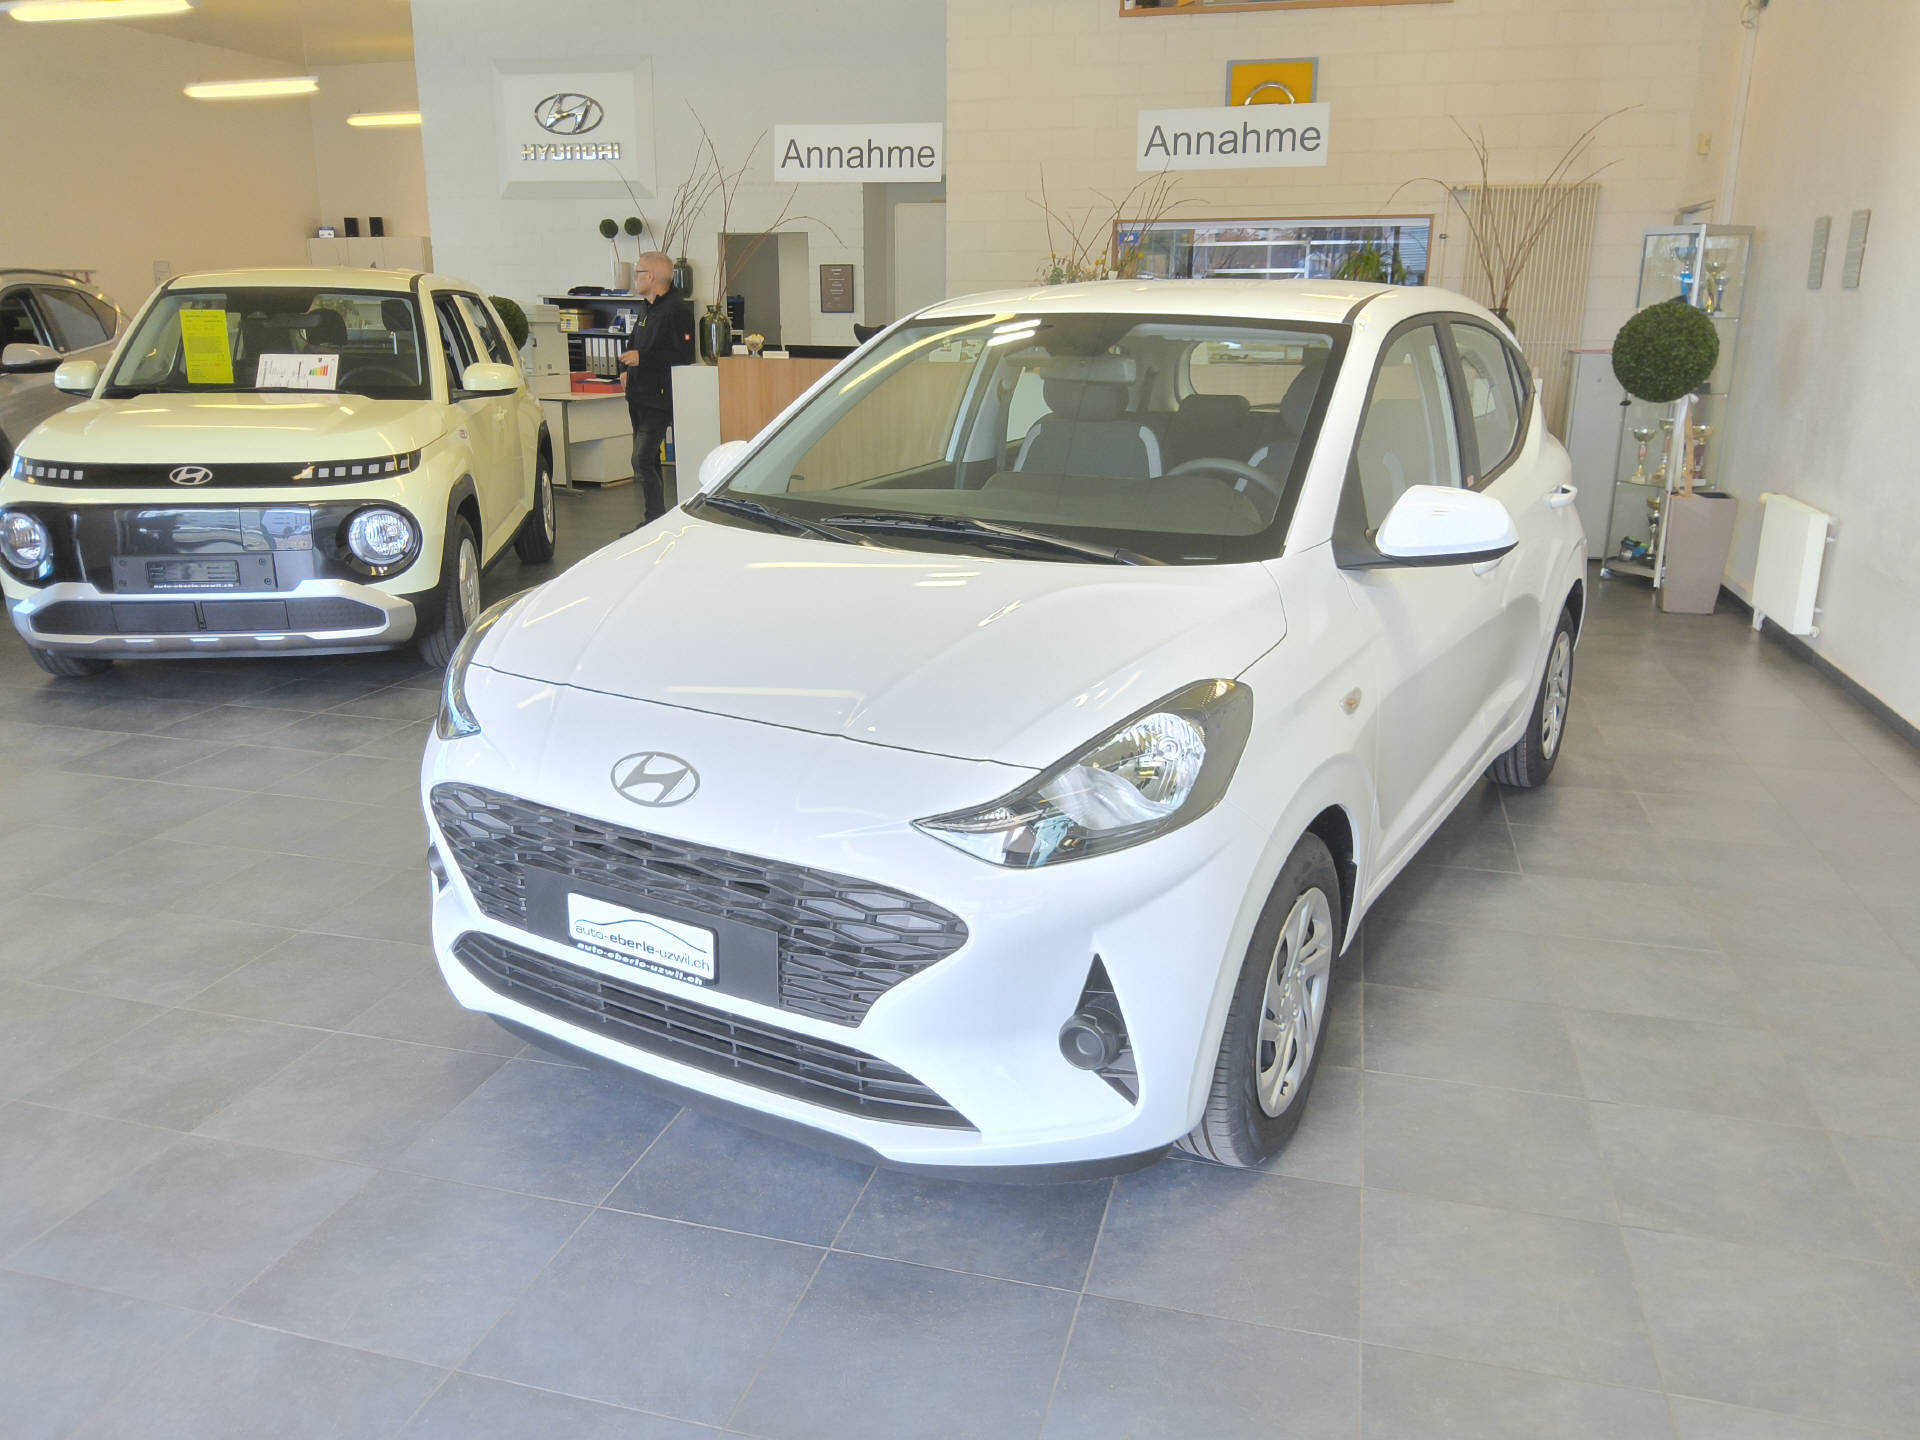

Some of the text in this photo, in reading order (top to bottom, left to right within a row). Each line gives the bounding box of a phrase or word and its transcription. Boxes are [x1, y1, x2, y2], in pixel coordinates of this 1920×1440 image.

[519, 142, 621, 160] HYUNDAI
[780, 138, 936, 169] Annahme
[1143, 121, 1321, 157] Annahme
[574, 924, 711, 973] auto-eberle-uzwil.ch
